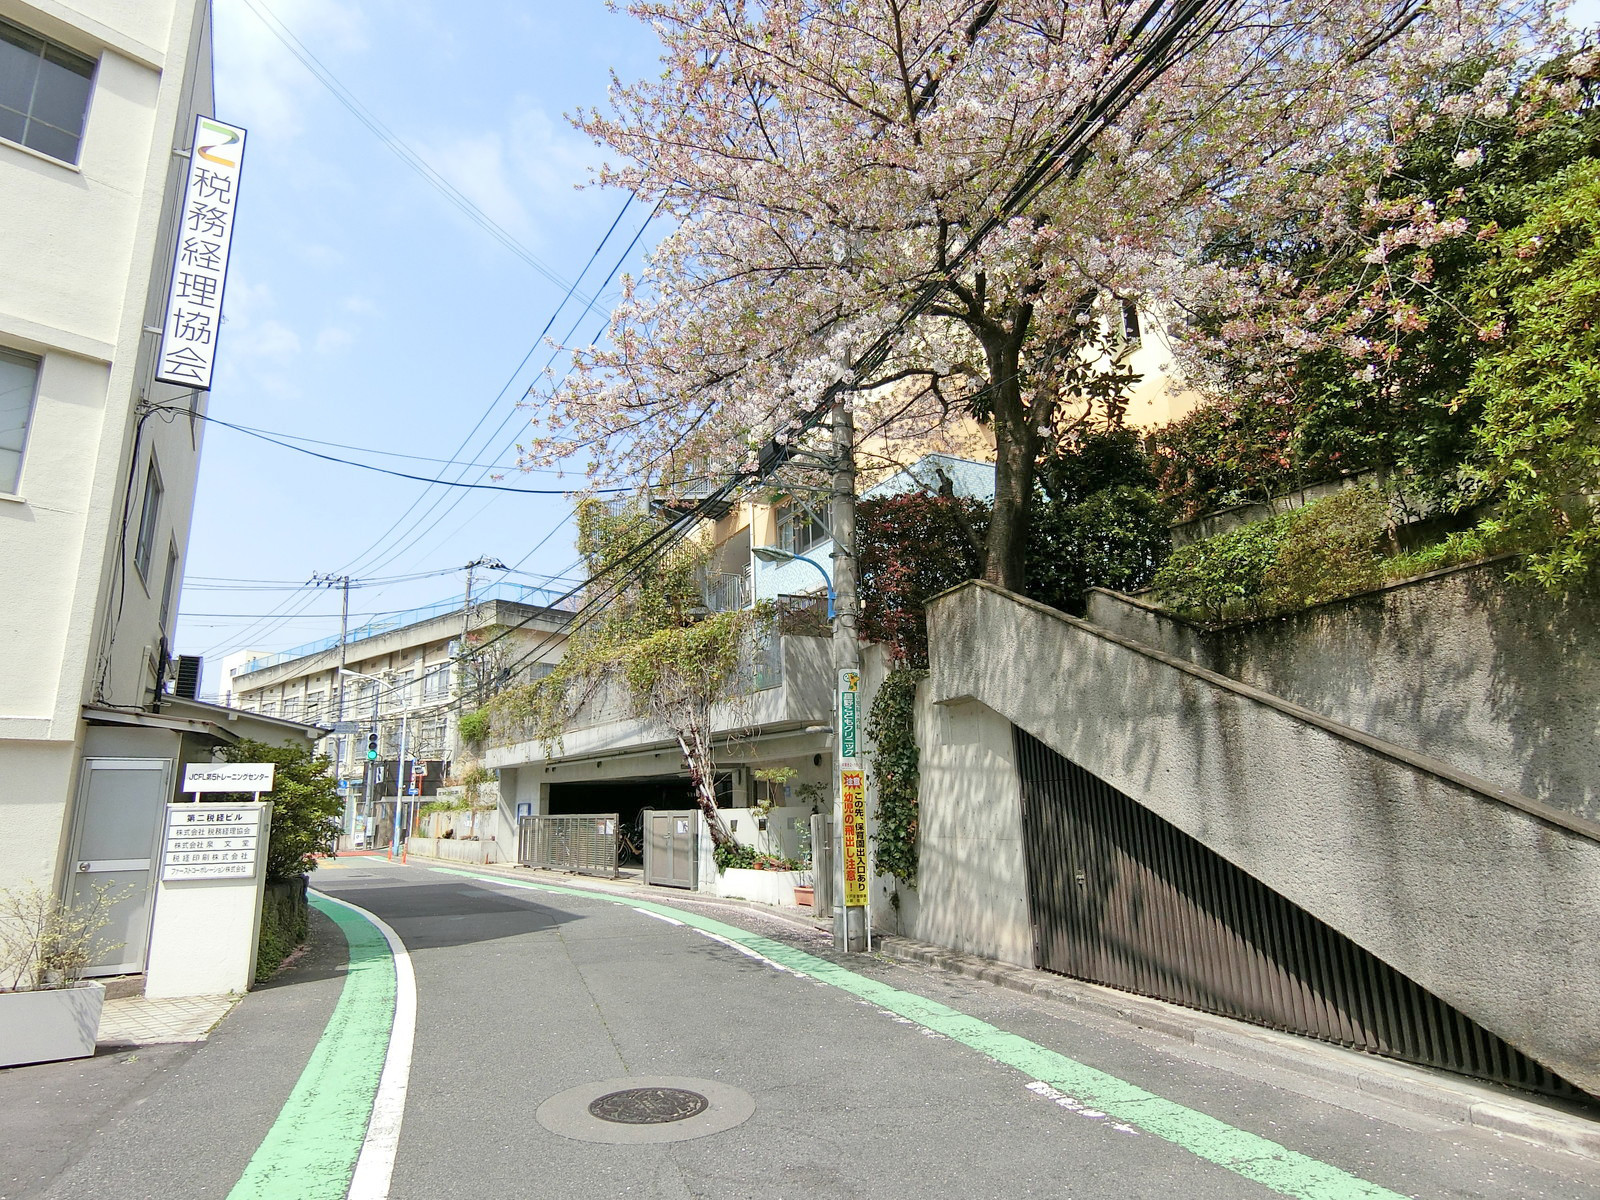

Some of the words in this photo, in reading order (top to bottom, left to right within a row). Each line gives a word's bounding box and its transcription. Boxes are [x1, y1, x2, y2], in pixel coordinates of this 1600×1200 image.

[164, 166, 231, 382] 税務経理協会
[187, 813, 243, 822] 第二税経ビル
[176, 828, 205, 836] 株式会社
[174, 841, 204, 849] 株式会社
[854, 792, 866, 892] この先、保育園出入口あり
